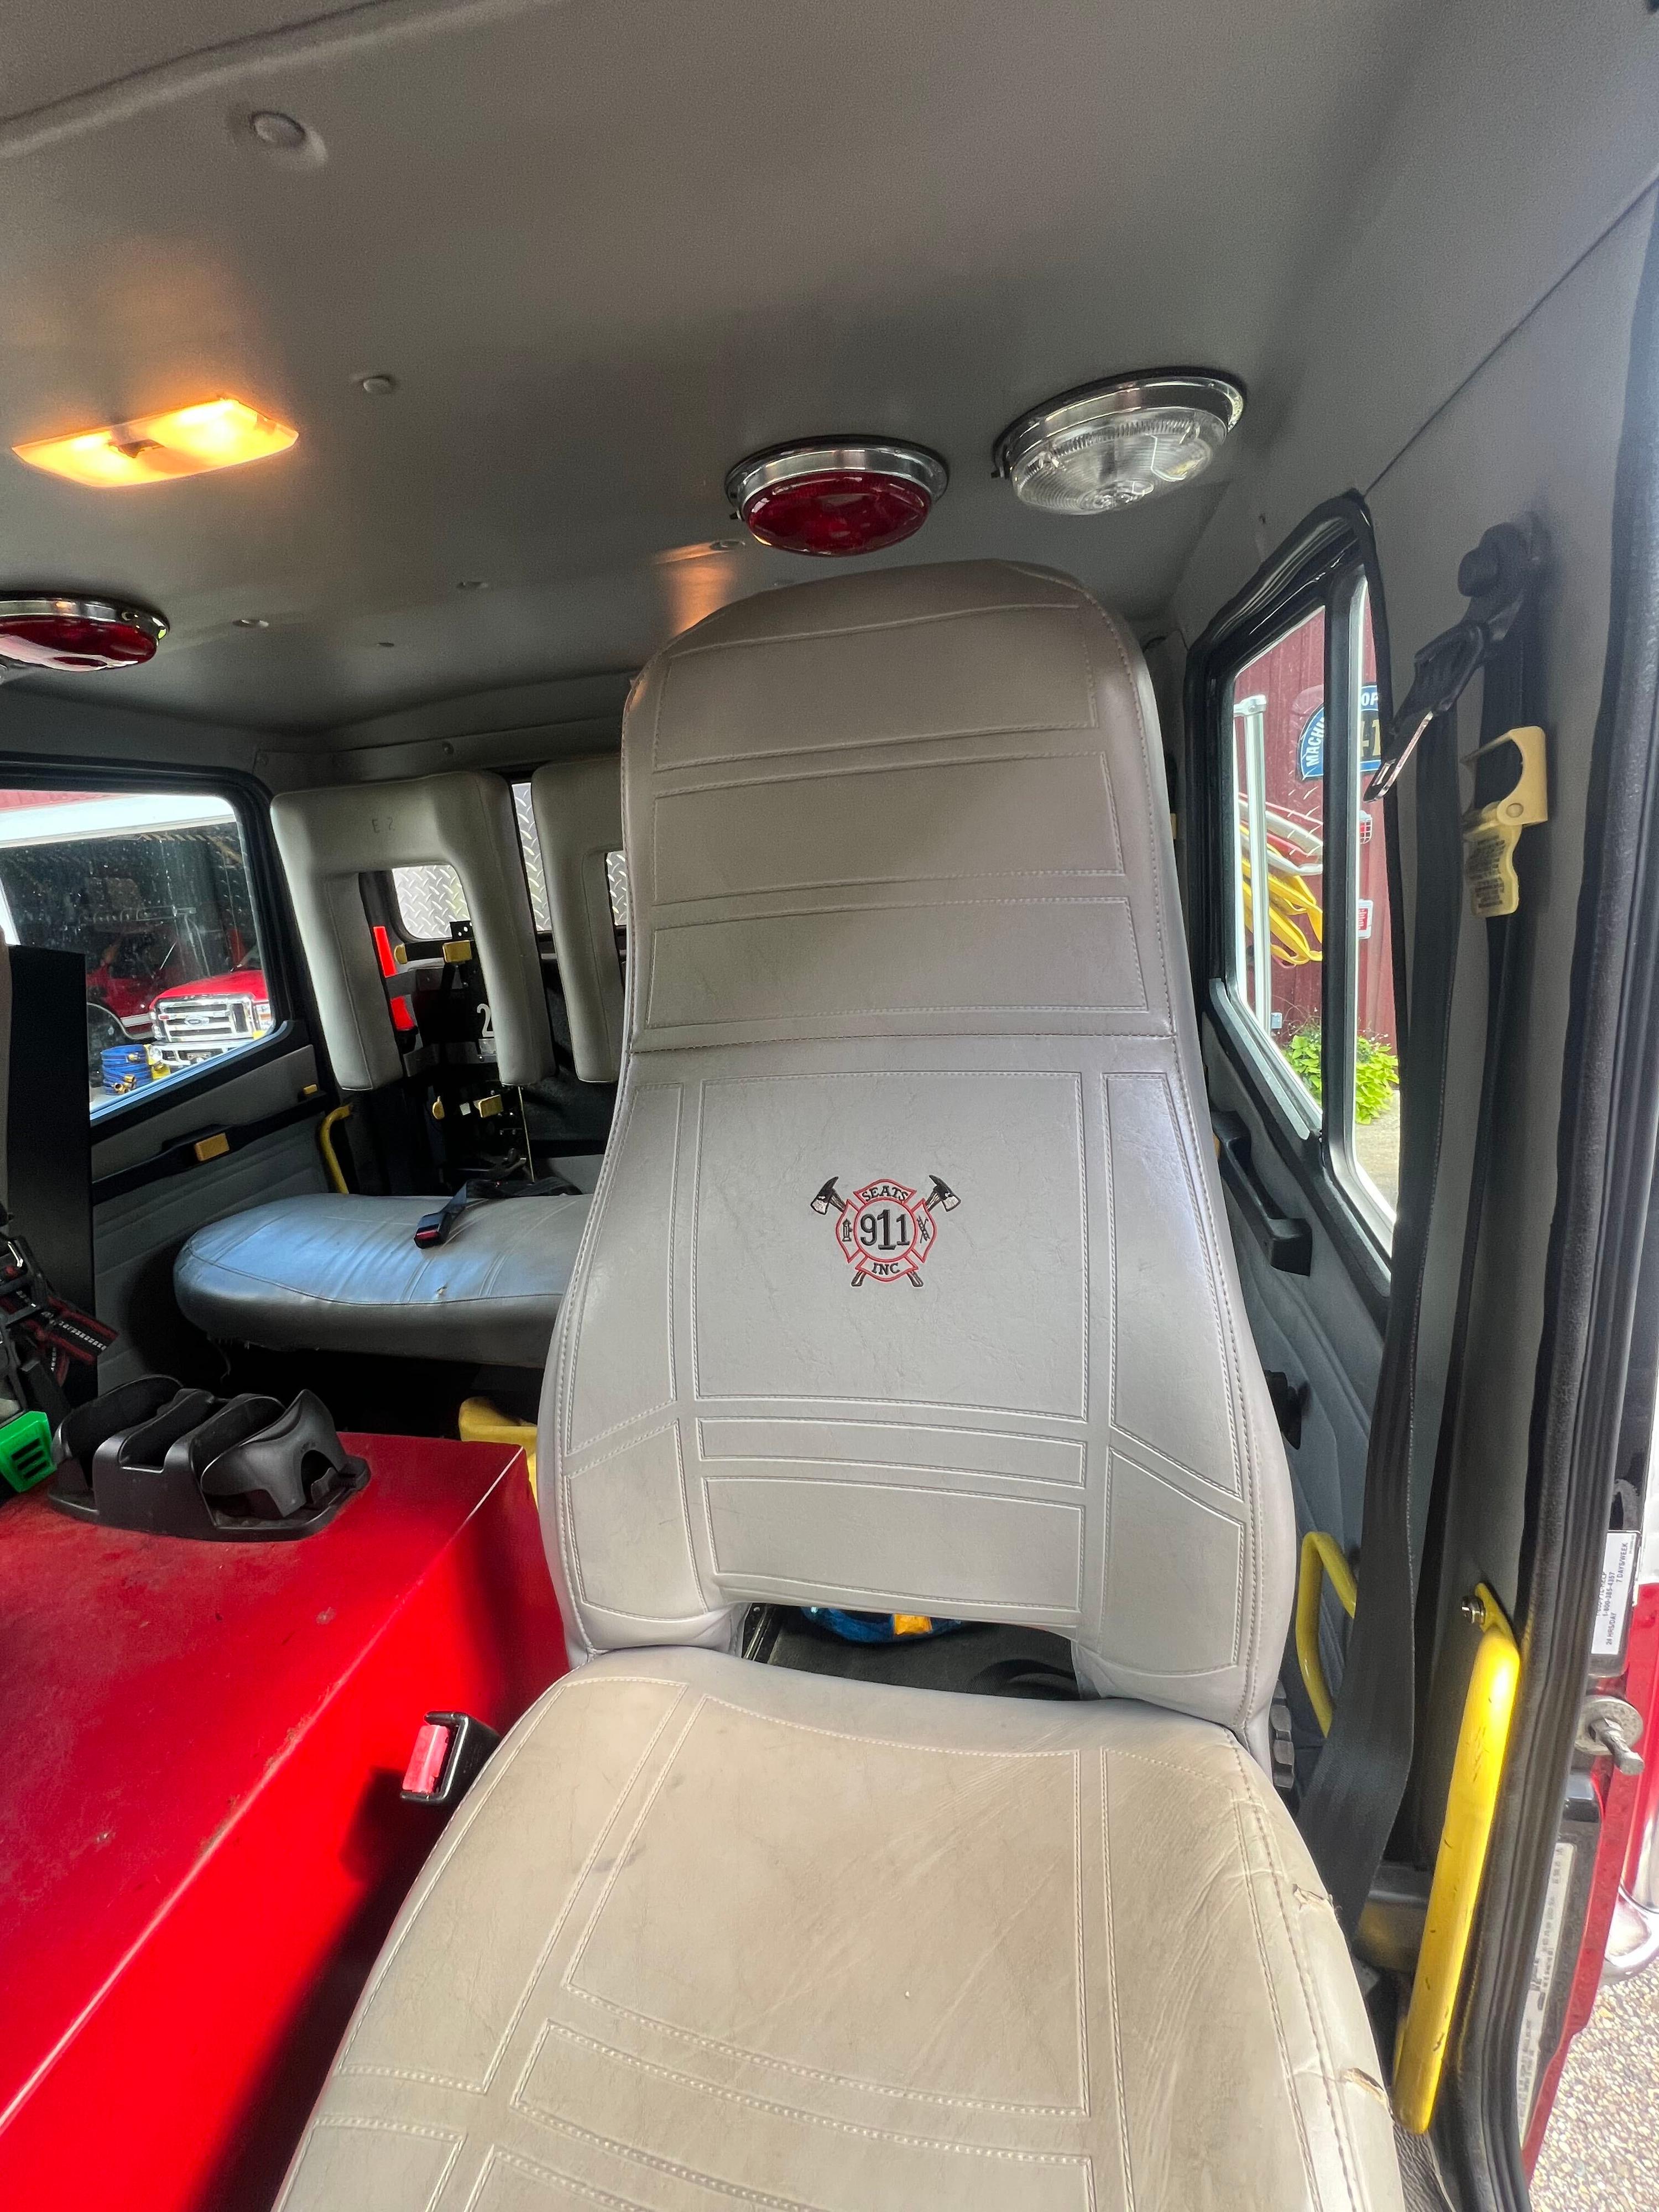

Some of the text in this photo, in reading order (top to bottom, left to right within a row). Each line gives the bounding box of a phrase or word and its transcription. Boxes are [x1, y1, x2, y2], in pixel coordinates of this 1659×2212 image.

[862, 1186, 908, 1202] SEATS
[860, 1209, 910, 1250] 911
[872, 1262, 900, 1275] INC
[1607, 1612, 1616, 1637] HRS/DAY
[1617, 1542, 1628, 1578] DAYS/WEEK
